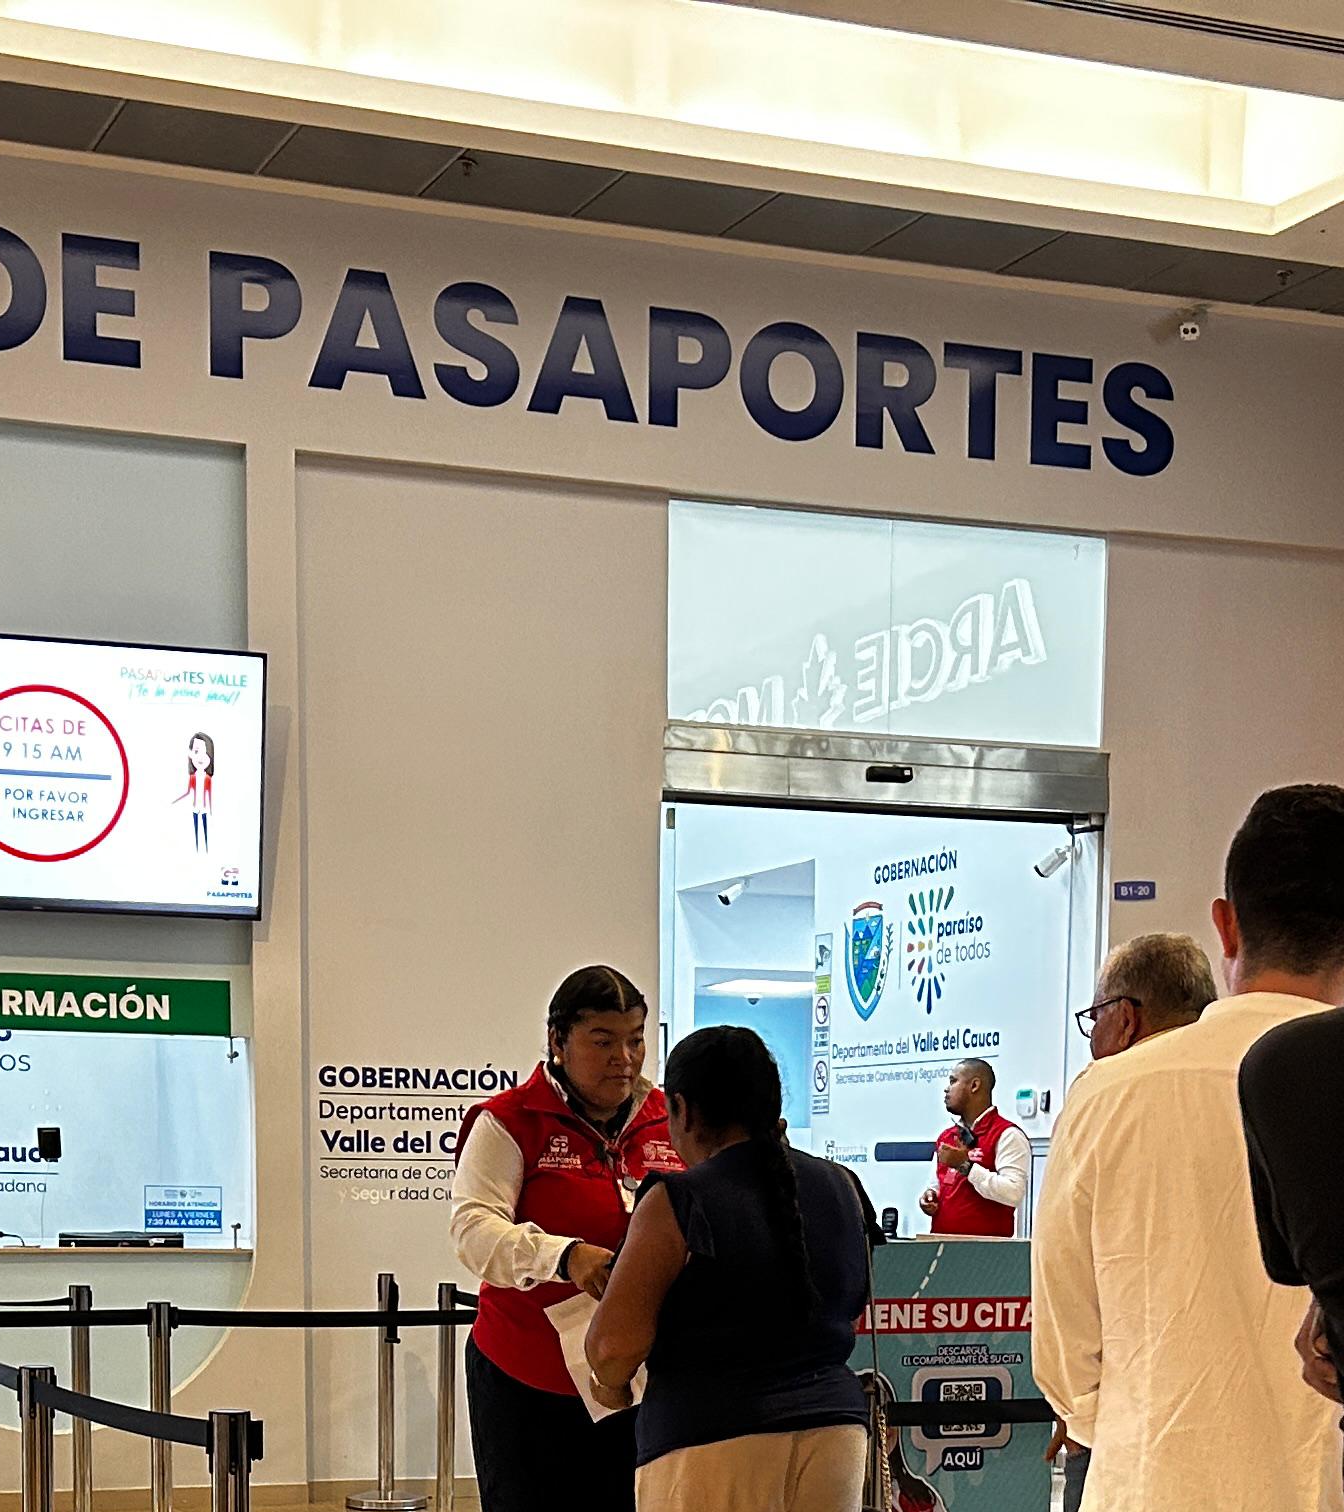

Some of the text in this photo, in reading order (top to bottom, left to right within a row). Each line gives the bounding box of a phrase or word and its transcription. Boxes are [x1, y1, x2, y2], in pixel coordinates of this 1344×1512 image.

[208, 250, 1176, 476] PASAPORTES
[208, 673, 248, 687] VALLE
[63, 719, 86, 736] DE
[50, 745, 83, 761] AM
[4, 788, 88, 804] POR FAVOR
[12, 807, 84, 822] INGRESAR
[874, 845, 958, 885] GOBERNACIÓN
[1120, 885, 1150, 896] B1-20
[937, 911, 983, 943] paraíso
[936, 936, 991, 965] de todos
[832, 1028, 1000, 1062] Departamento del Valle del Cauca
[318, 1063, 518, 1091] GOBERNACIÓN
[319, 1099, 466, 1124] Departament
[320, 1130, 386, 1153] Valle
[392, 1131, 432, 1154] del
[401, 1166, 422, 1180] de
[152, 1210, 176, 1218] LUNES
[184, 1211, 215, 1219] VIERNES
[931, 1302, 969, 1329] SU
[974, 1301, 1033, 1328] CITA
[937, 1345, 988, 1356] DESCARGUE
[903, 1354, 1022, 1366] EL COMPROBANTE DE SU CITA
[944, 1448, 981, 1467] AQUÍ
